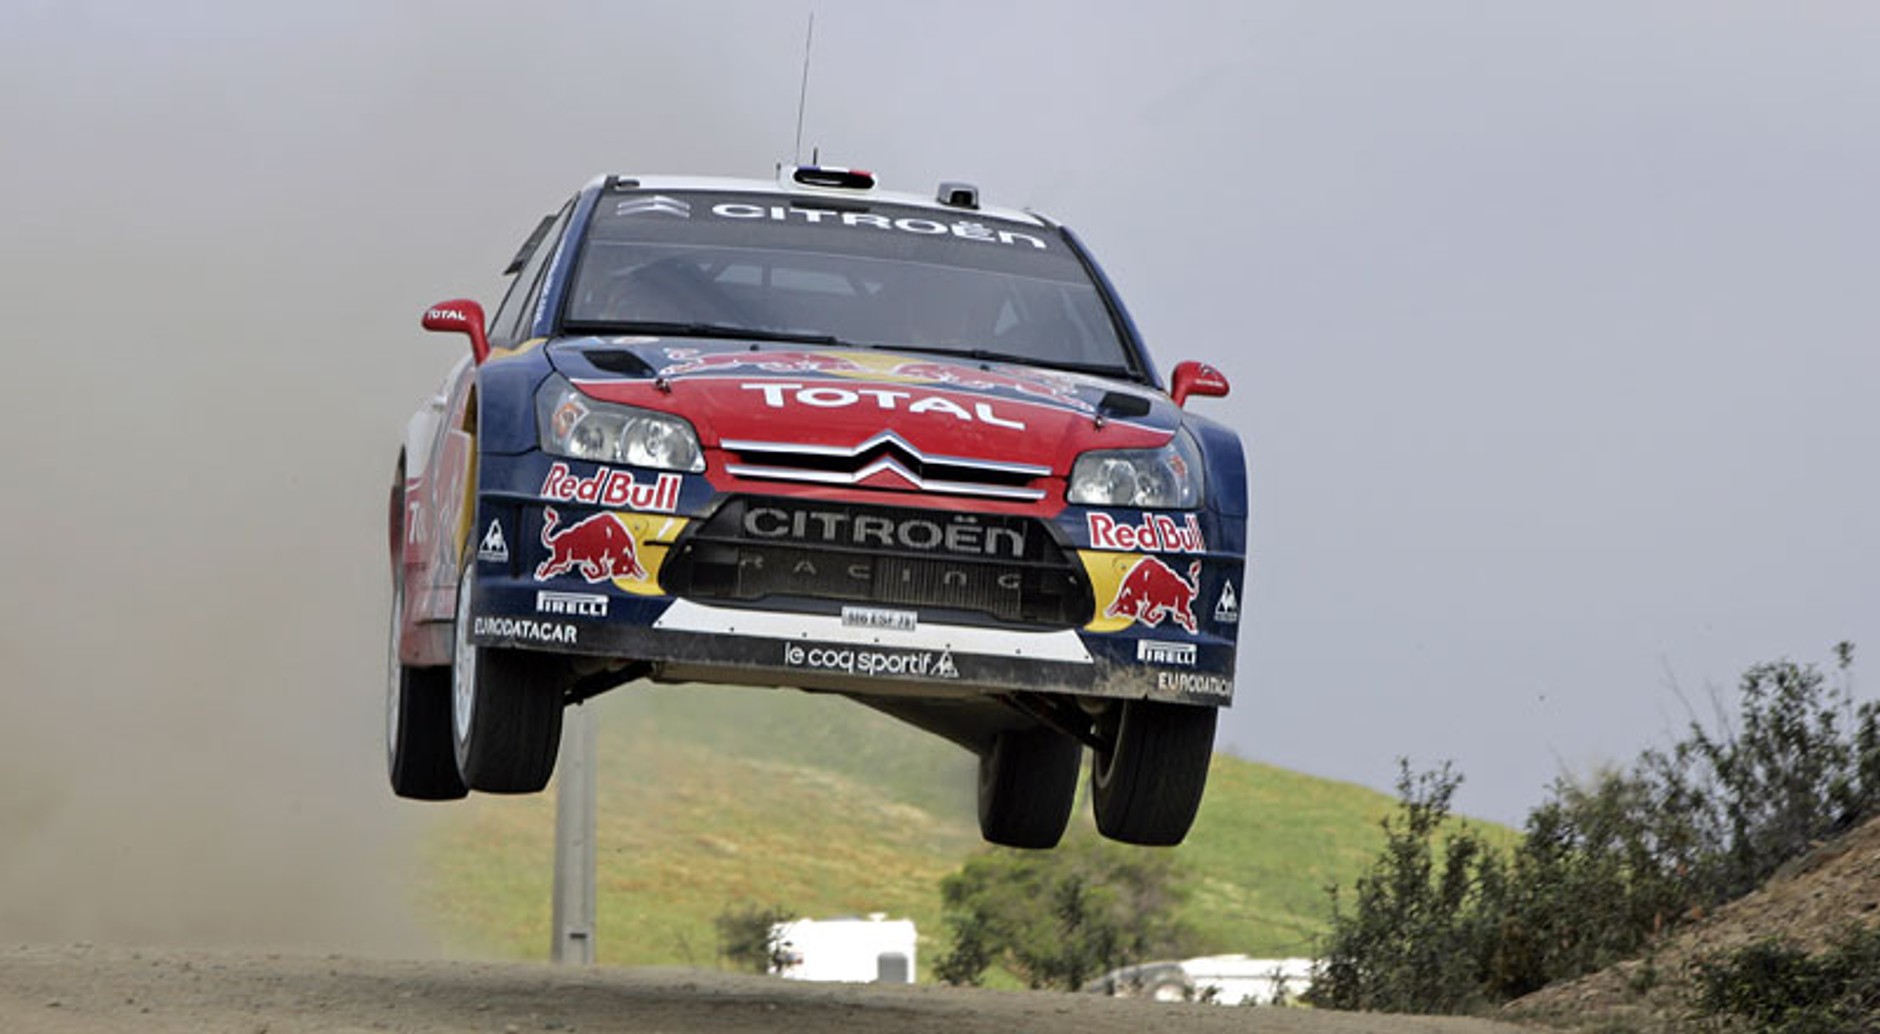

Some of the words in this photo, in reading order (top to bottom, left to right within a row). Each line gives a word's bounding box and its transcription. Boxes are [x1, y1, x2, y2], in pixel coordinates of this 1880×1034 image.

[741, 382, 1026, 430] TOTAL
[540, 462, 610, 504] Red
[601, 469, 683, 513] Bull
[1086, 511, 1162, 552] Red
[1154, 512, 1207, 553] Bull
[536, 590, 609, 617] PIRELLI
[474, 616, 578, 644] EURODATACAR
[784, 641, 805, 665] le
[808, 648, 855, 675] coq
[857, 651, 932, 677] sportif
[1137, 639, 1197, 666] PIRELLI
